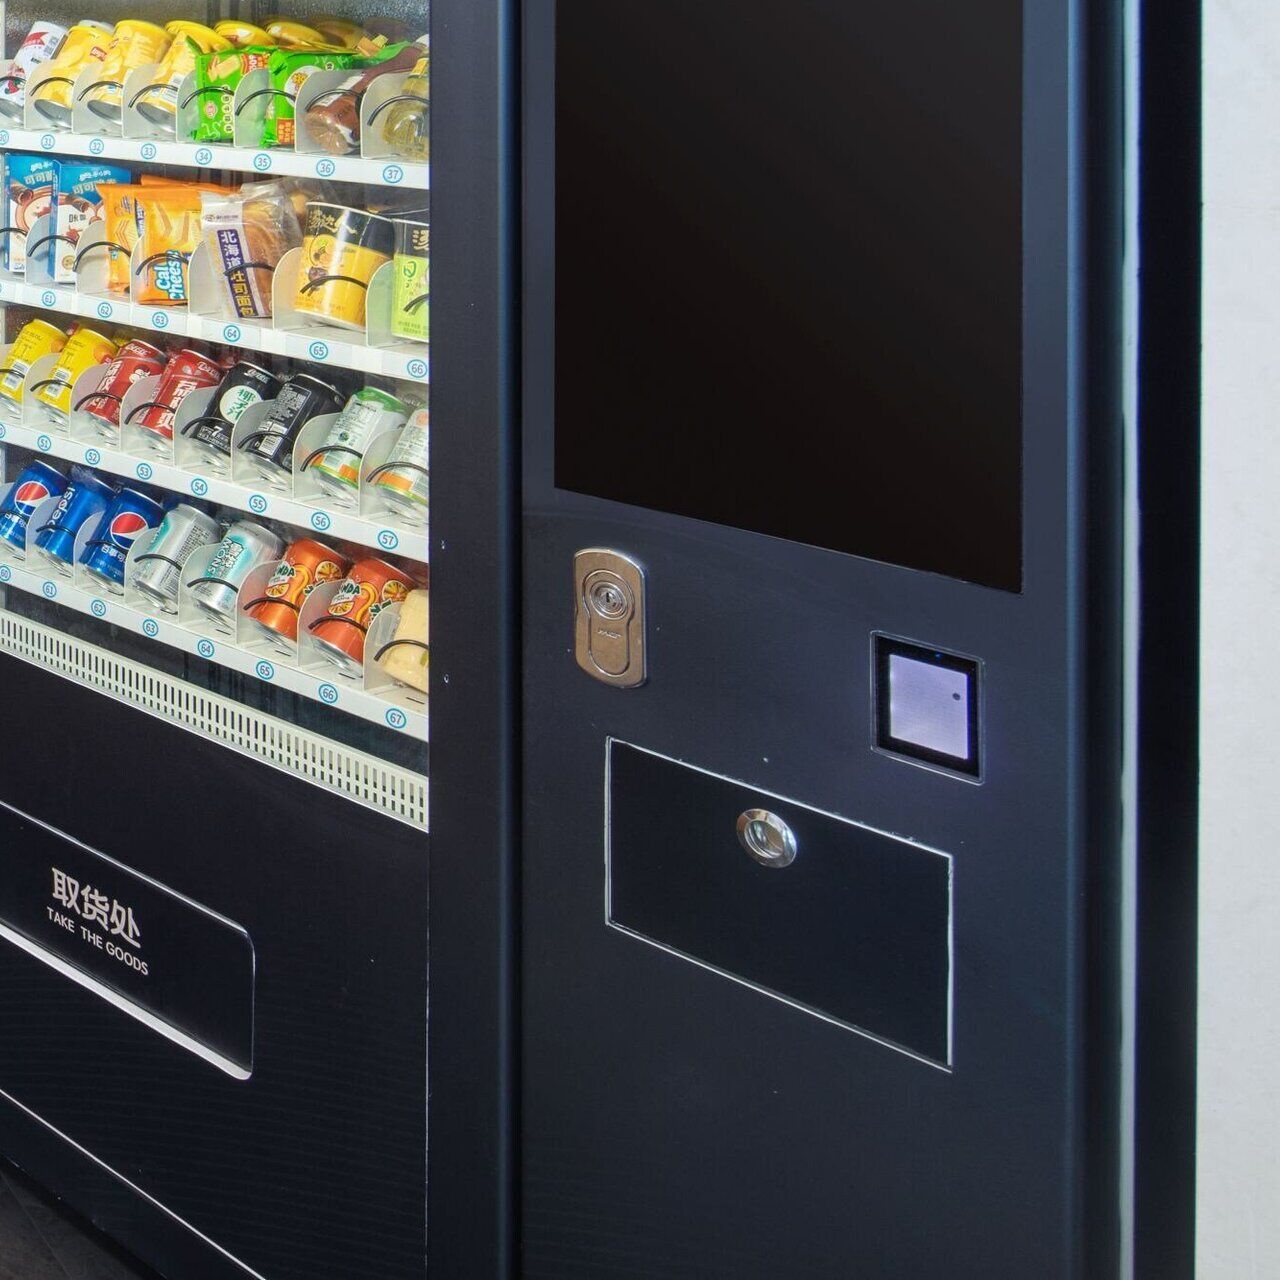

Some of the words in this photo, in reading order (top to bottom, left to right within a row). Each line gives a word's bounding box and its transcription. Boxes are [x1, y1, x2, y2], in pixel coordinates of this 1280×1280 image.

[144, 146, 153, 157] 33
[199, 151, 208, 163] 34
[257, 156, 268, 168] 35
[320, 162, 331, 175] 36
[387, 168, 399, 181] 37
[154, 263, 171, 291] Cal
[155, 315, 165, 326] 63
[227, 328, 237, 340] 64
[313, 345, 324, 357] 65
[411, 362, 423, 376] 66
[140, 466, 149, 477] 53
[195, 482, 204, 493] 54
[253, 498, 263, 510] 55
[315, 515, 326, 528] 56
[382, 534, 394, 547] 57
[207, 536, 233, 574] SNOW
[146, 622, 155, 633] 63
[201, 643, 211, 655] 64
[260, 665, 270, 676] 65
[323, 688, 334, 700] 66
[390, 712, 402, 725] 67
[52, 867, 141, 949] 取货处
[47, 906, 75, 933] TAKE
[80, 926, 103, 949] THE
[106, 942, 149, 975] GOODS
